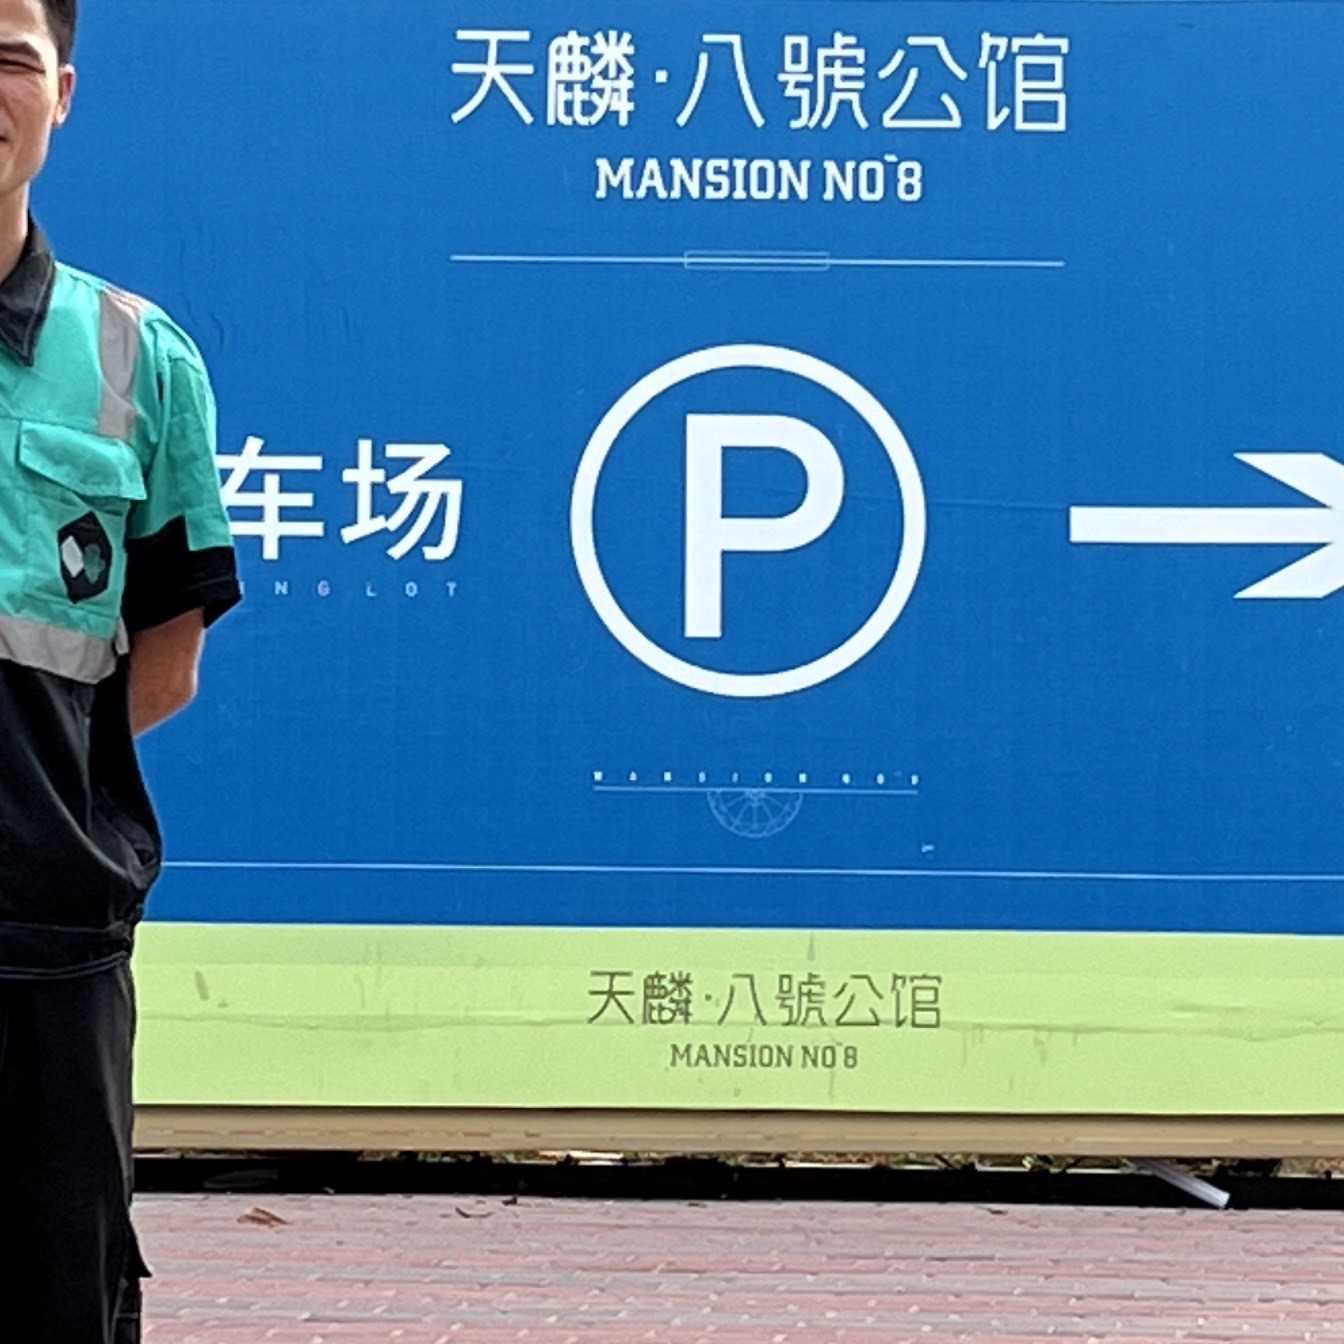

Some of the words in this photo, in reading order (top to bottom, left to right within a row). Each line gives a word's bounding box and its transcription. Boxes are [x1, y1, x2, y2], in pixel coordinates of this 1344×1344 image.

[594, 156, 812, 201] MANSION
[215, 434, 463, 561] 车场
[684, 413, 845, 639] P
[669, 1043, 794, 1069] MANSION
